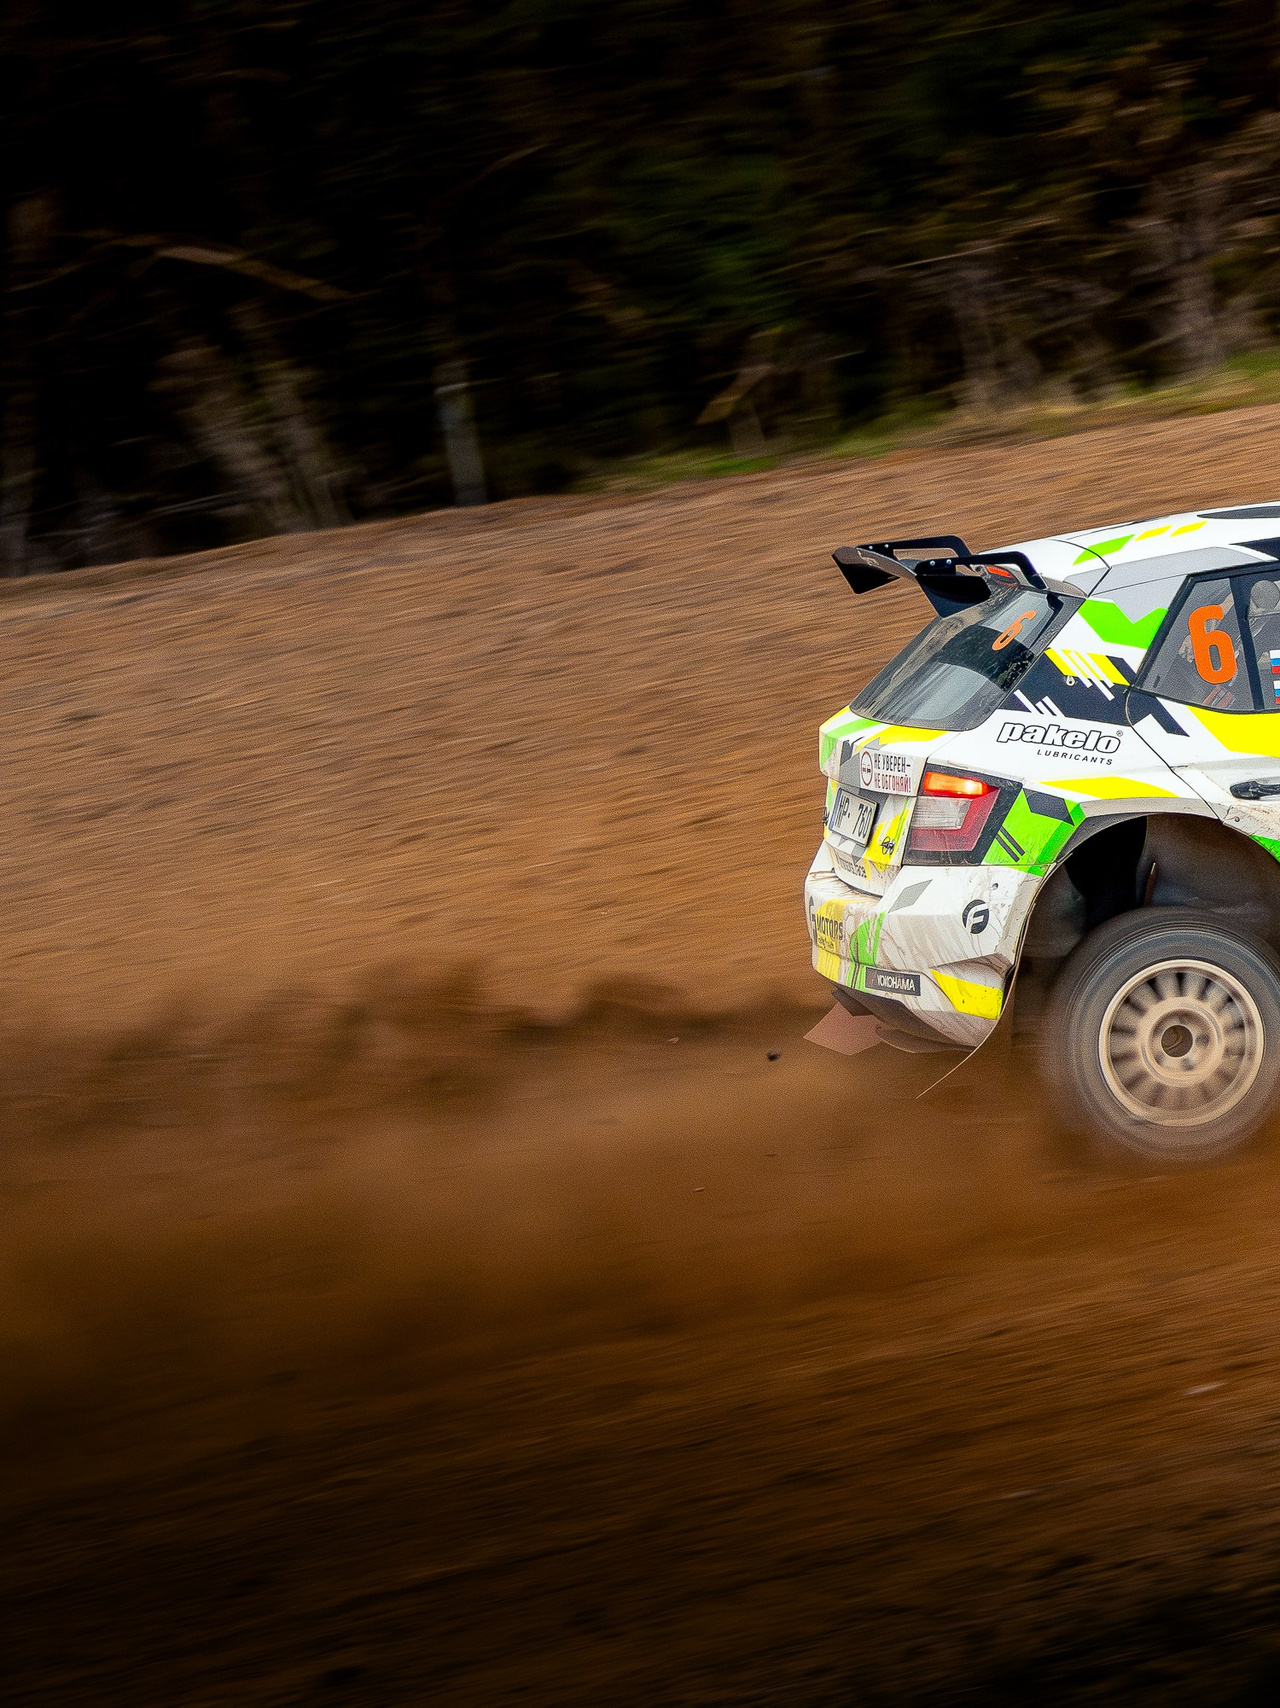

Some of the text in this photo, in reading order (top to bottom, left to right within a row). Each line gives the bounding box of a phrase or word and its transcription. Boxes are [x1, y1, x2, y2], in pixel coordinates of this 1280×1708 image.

[991, 609, 1037, 652] 6
[1188, 604, 1238, 685] 6
[996, 722, 1121, 754] pakelo
[1036, 748, 1113, 766] LUBRICANTS
[876, 974, 916, 992] YOKOHAMA
